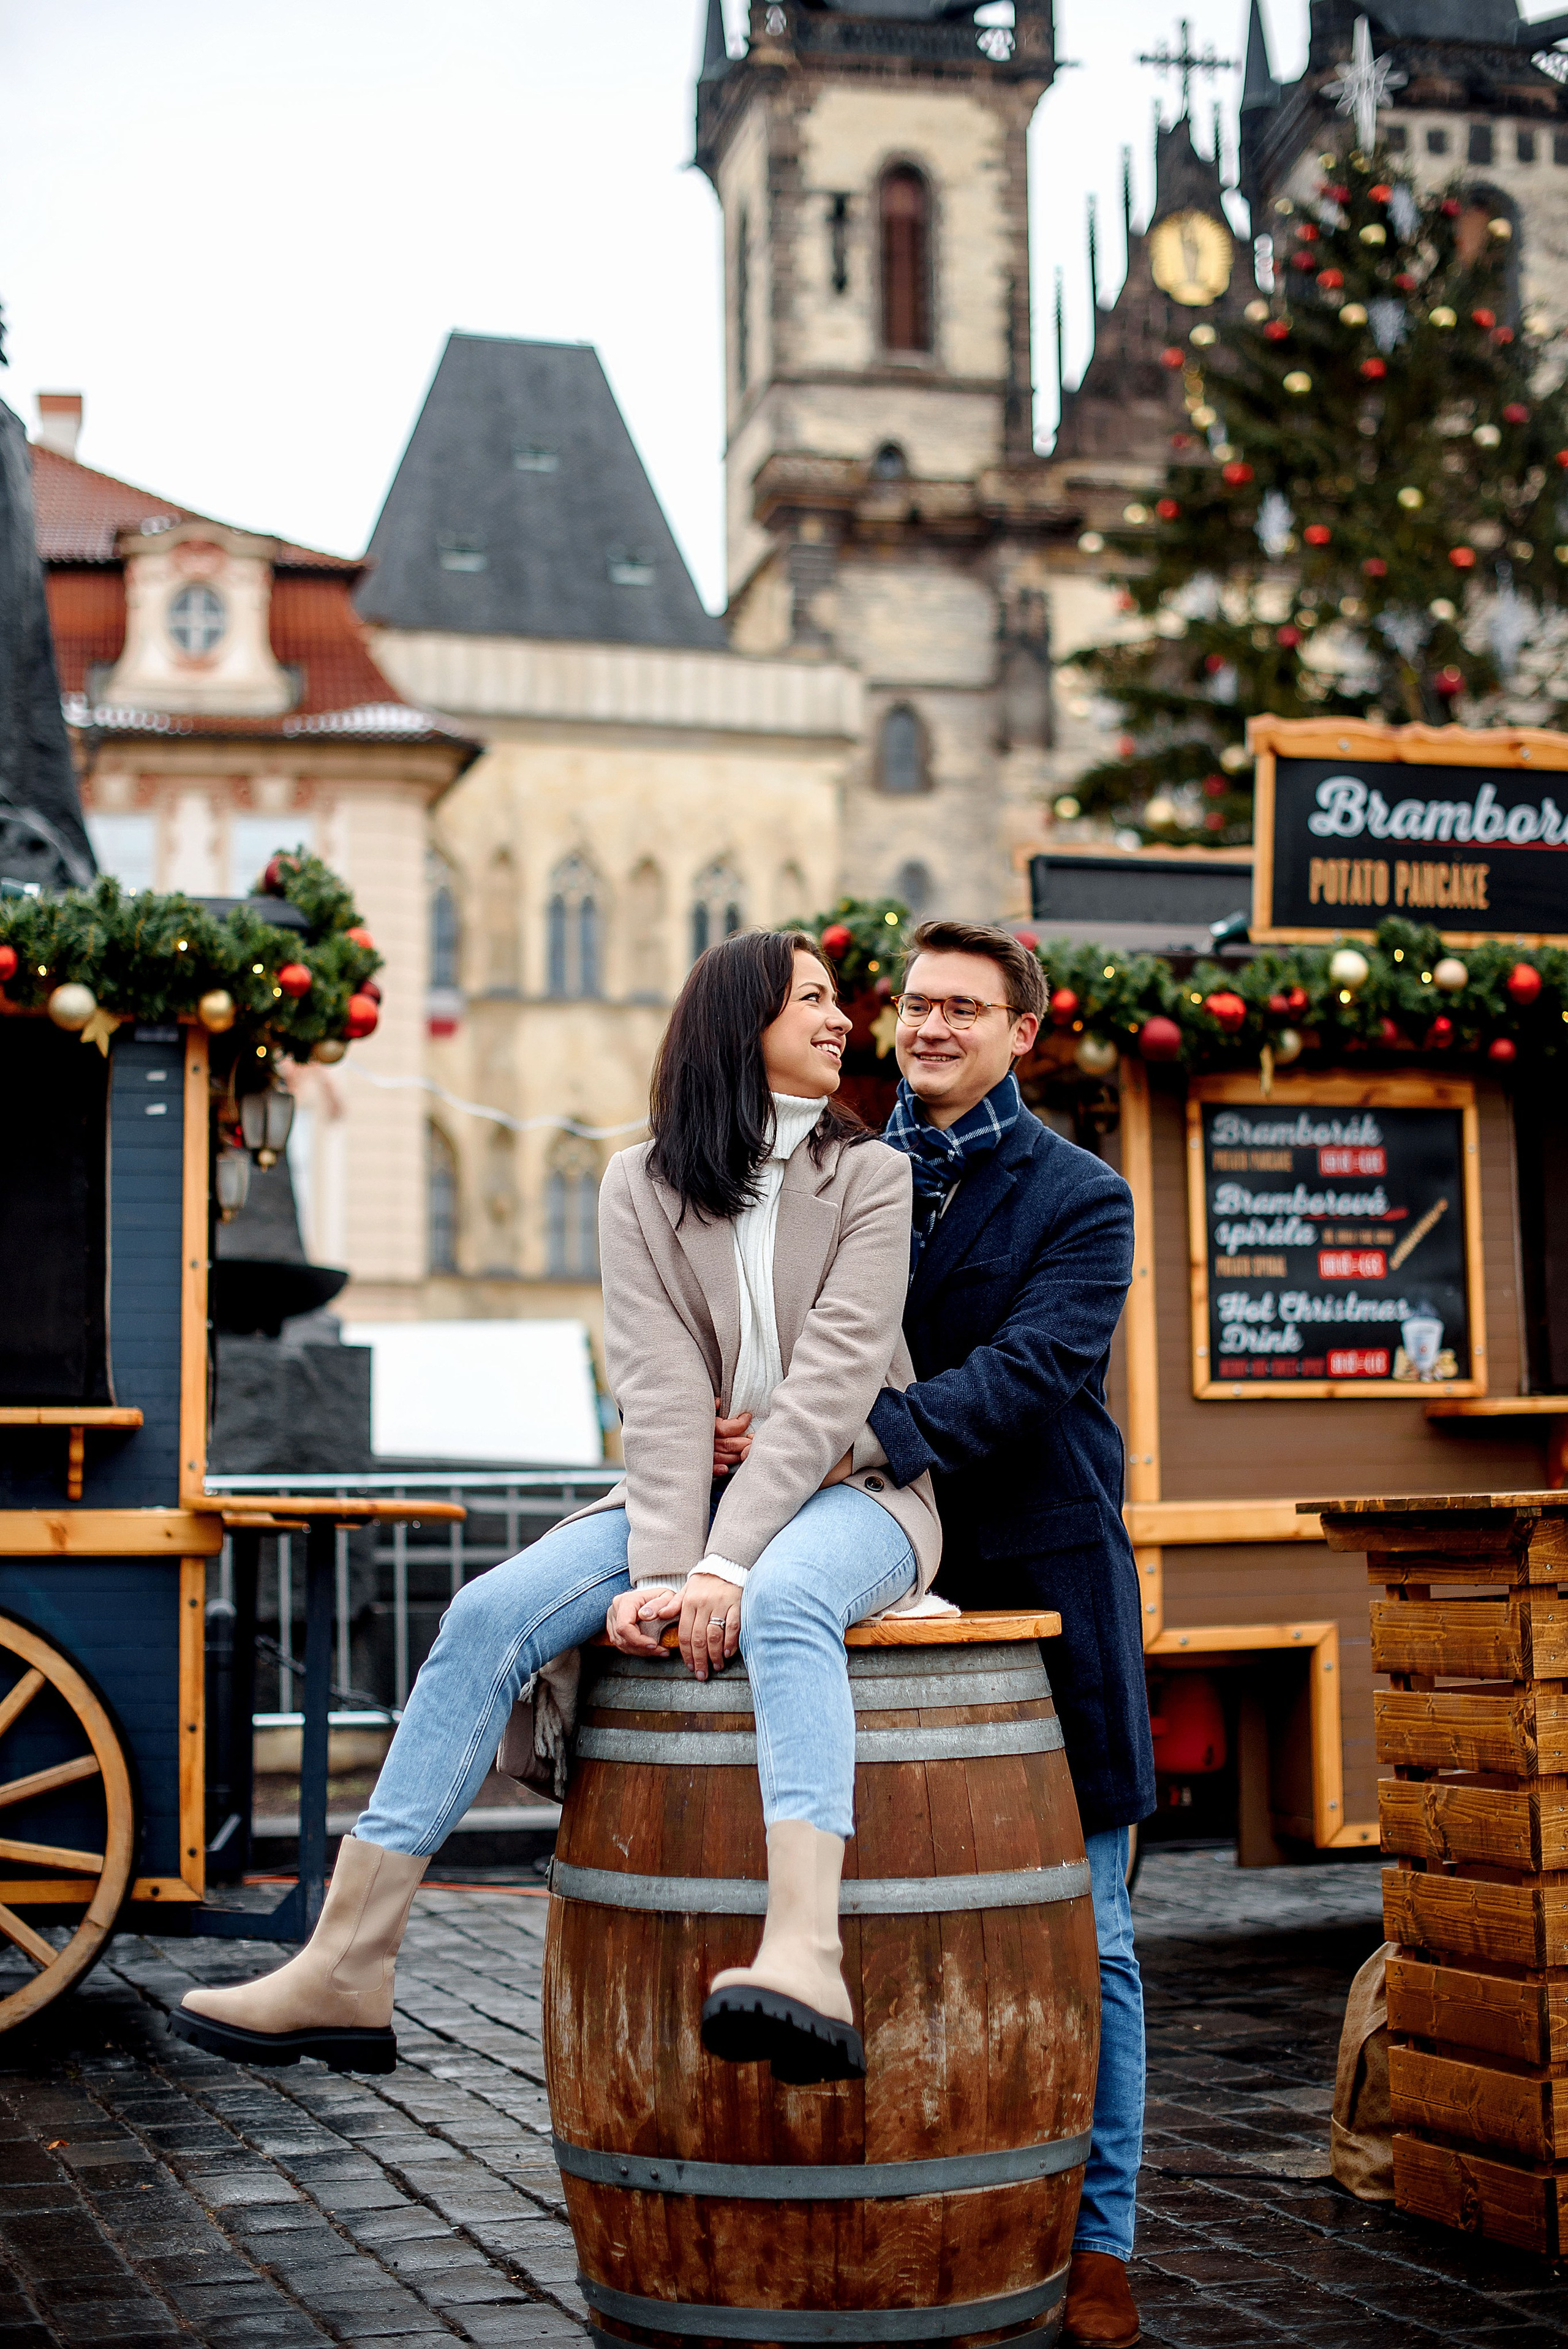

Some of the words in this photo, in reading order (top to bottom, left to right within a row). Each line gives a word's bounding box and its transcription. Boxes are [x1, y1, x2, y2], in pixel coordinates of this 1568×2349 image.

[1308, 775, 1568, 846] Brambor
[1309, 858, 1389, 906] POTATO
[1395, 860, 1490, 910] PANCAKE
[1217, 1290, 1276, 1323] Hot
[1279, 1290, 1411, 1322] Christmas
[1218, 1323, 1303, 1354] Drink
